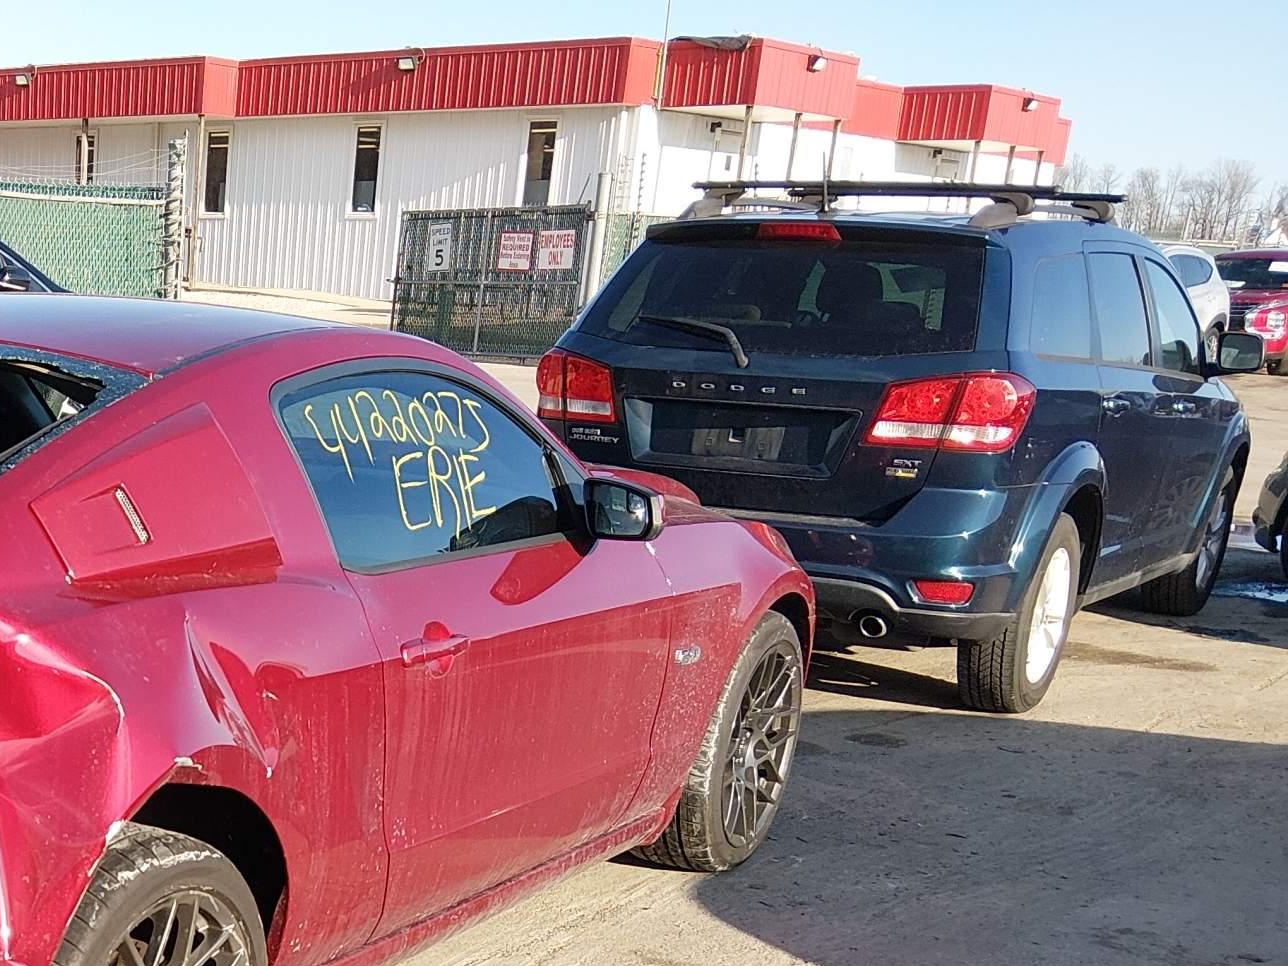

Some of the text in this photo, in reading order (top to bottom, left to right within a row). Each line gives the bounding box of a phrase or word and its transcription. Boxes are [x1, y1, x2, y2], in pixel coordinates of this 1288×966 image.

[431, 227, 451, 236] SPEED
[432, 238, 448, 246] LIMIT
[502, 243, 530, 251] REQUIRED
[540, 234, 574, 249] EMPLOYEES
[434, 249, 444, 266] 5
[548, 251, 563, 265] ONLY
[671, 380, 807, 396] DODGE
[304, 389, 491, 484] 44220275
[569, 433, 620, 444] JOURNEY
[893, 459, 922, 468] SXT
[391, 445, 497, 540] ERIE
